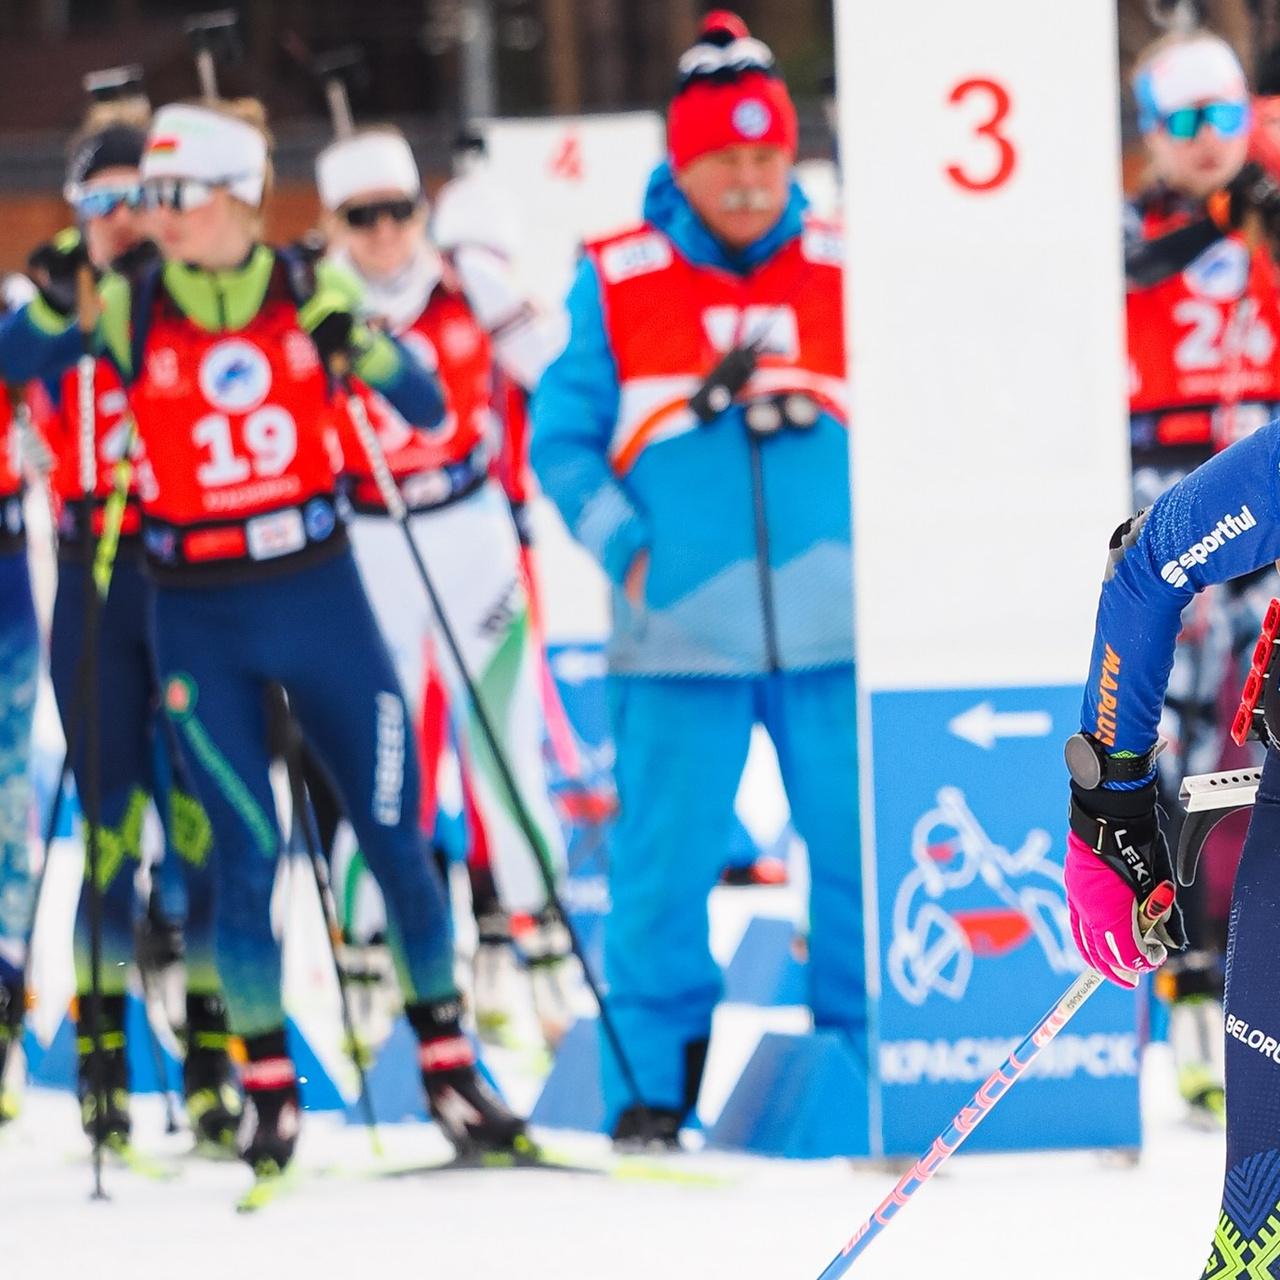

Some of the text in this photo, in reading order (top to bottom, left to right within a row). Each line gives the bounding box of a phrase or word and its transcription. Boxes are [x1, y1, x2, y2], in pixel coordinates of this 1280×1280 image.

[943, 77, 1020, 193] 3
[1172, 298, 1276, 370] 24
[191, 403, 299, 489] 19
[1179, 505, 1257, 570] sportful
